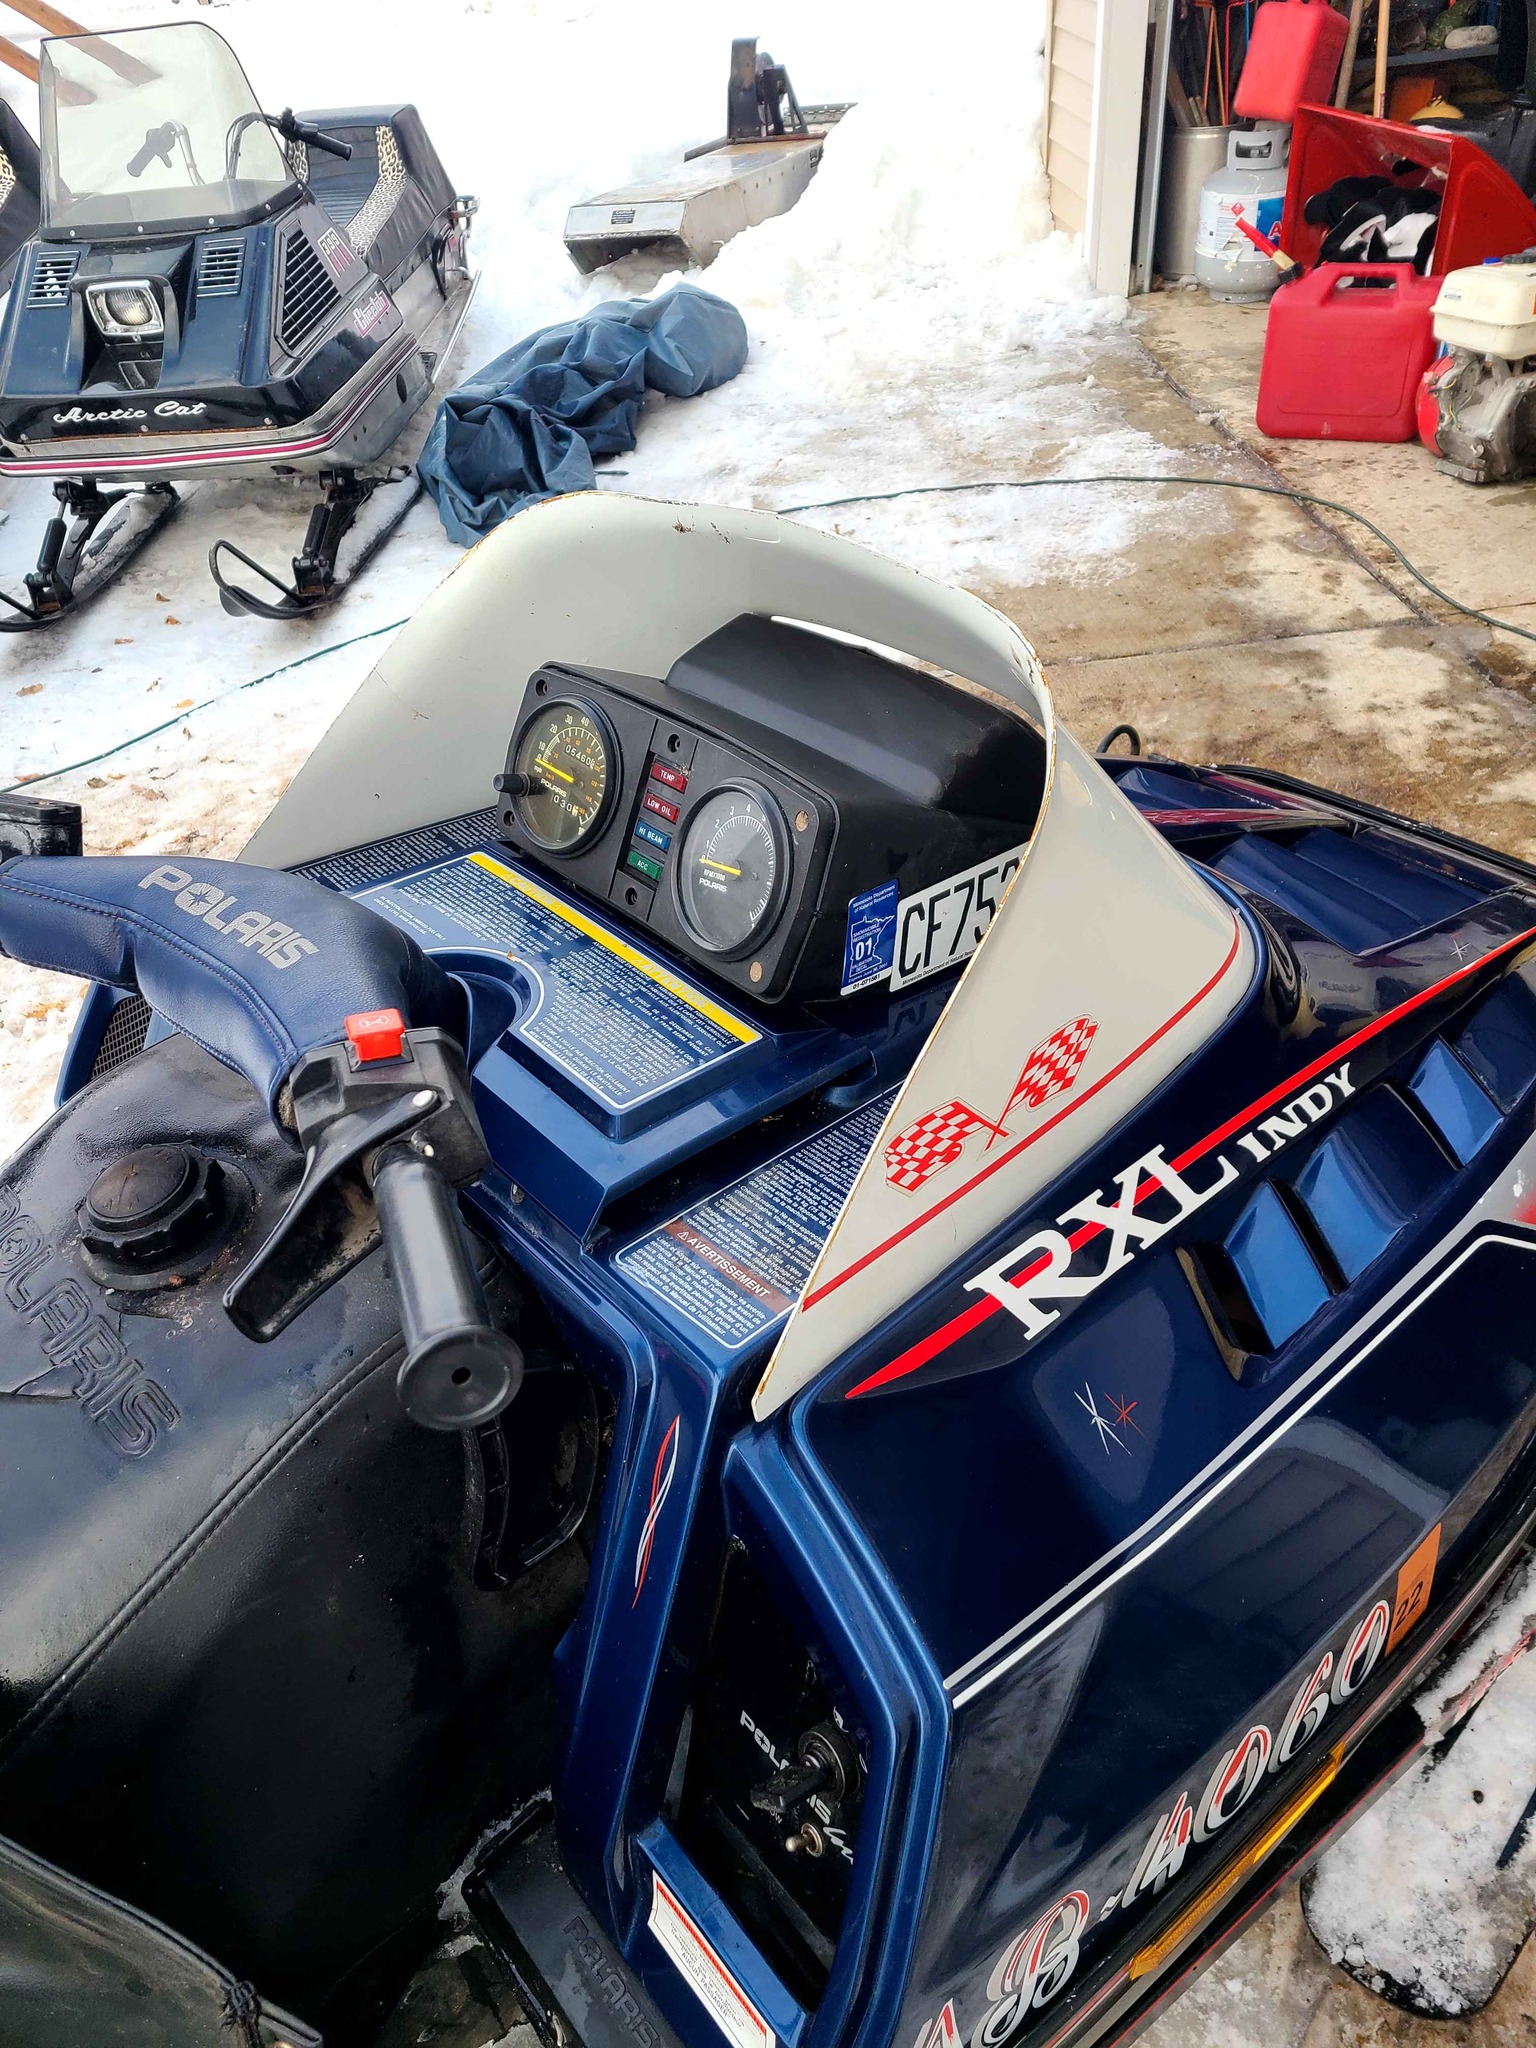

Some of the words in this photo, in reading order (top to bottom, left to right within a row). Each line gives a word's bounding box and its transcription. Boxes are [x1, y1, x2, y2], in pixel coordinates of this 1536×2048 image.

[353, 290, 389, 331] Cheetah
[53, 406, 147, 423] Arctic
[154, 400, 207, 417] Cat
[550, 724, 558, 734] 20
[564, 714, 573, 725] 30
[581, 716, 590, 727] 40
[538, 741, 546, 750] 10
[660, 770, 675, 781] TEMP
[540, 778, 568, 798] POLARIS
[647, 798, 660, 810] LOW
[662, 805, 672, 816] OIL
[730, 806, 735, 816] 3
[746, 804, 751, 813] 4
[715, 819, 720, 828] 2
[638, 826, 646, 836] HI
[647, 831, 663, 845] BEAM
[706, 840, 710, 849] 1
[637, 860, 648, 871] ACC
[699, 878, 728, 893] POLARIS
[138, 864, 320, 969] POLARIS
[855, 938, 872, 961] 01
[902, 973, 923, 986] Minnesota
[923, 962, 946, 977] Department
[950, 952, 964, 962] Natural
[1237, 1062, 1356, 1163] INDY
[655, 1236, 672, 1247] Lisez
[963, 1144, 1240, 1341] RXL
[682, 1236, 773, 1298] AVERTISSEMENT
[697, 1267, 710, 1276] de
[635, 1247, 658, 1262] graves
[653, 1260, 671, 1272] voire
[665, 1270, 696, 1291] mortelles
[689, 1290, 716, 1307] peuvent
[711, 1306, 737, 1323] résulter
[733, 1321, 751, 1333] d'un
[647, 1240, 673, 1257] sements
[680, 1264, 704, 1280] Manuel
[706, 1283, 740, 1307] l'utilisateur
[735, 1305, 755, 1318] avant
[750, 1316, 763, 1324] de
[653, 1252, 688, 1276] fonctionner
[689, 1280, 718, 1299] machine.
[714, 1298, 730, 1308] Des
[725, 1307, 758, 1329] blessures
[660, 1284, 672, 1292] du
[703, 1274, 740, 1298] comprendre
[629, 1251, 644, 1261] non
[638, 1259, 662, 1275] respect
[658, 1273, 672, 1282] des
[665, 1281, 712, 1312] avertissements
[712, 1315, 733, 1329] d'une
[728, 1328, 743, 1338] non
[666, 1290, 692, 1307] Manuel
[736, 1296, 749, 1305] les
[686, 1304, 699, 1312] de
[692, 1310, 731, 1336] l'utilisateur.
[1393, 1581, 1423, 1632] 22
[740, 1710, 832, 1825] POLIS
[564, 1916, 661, 2048] POLARIS
